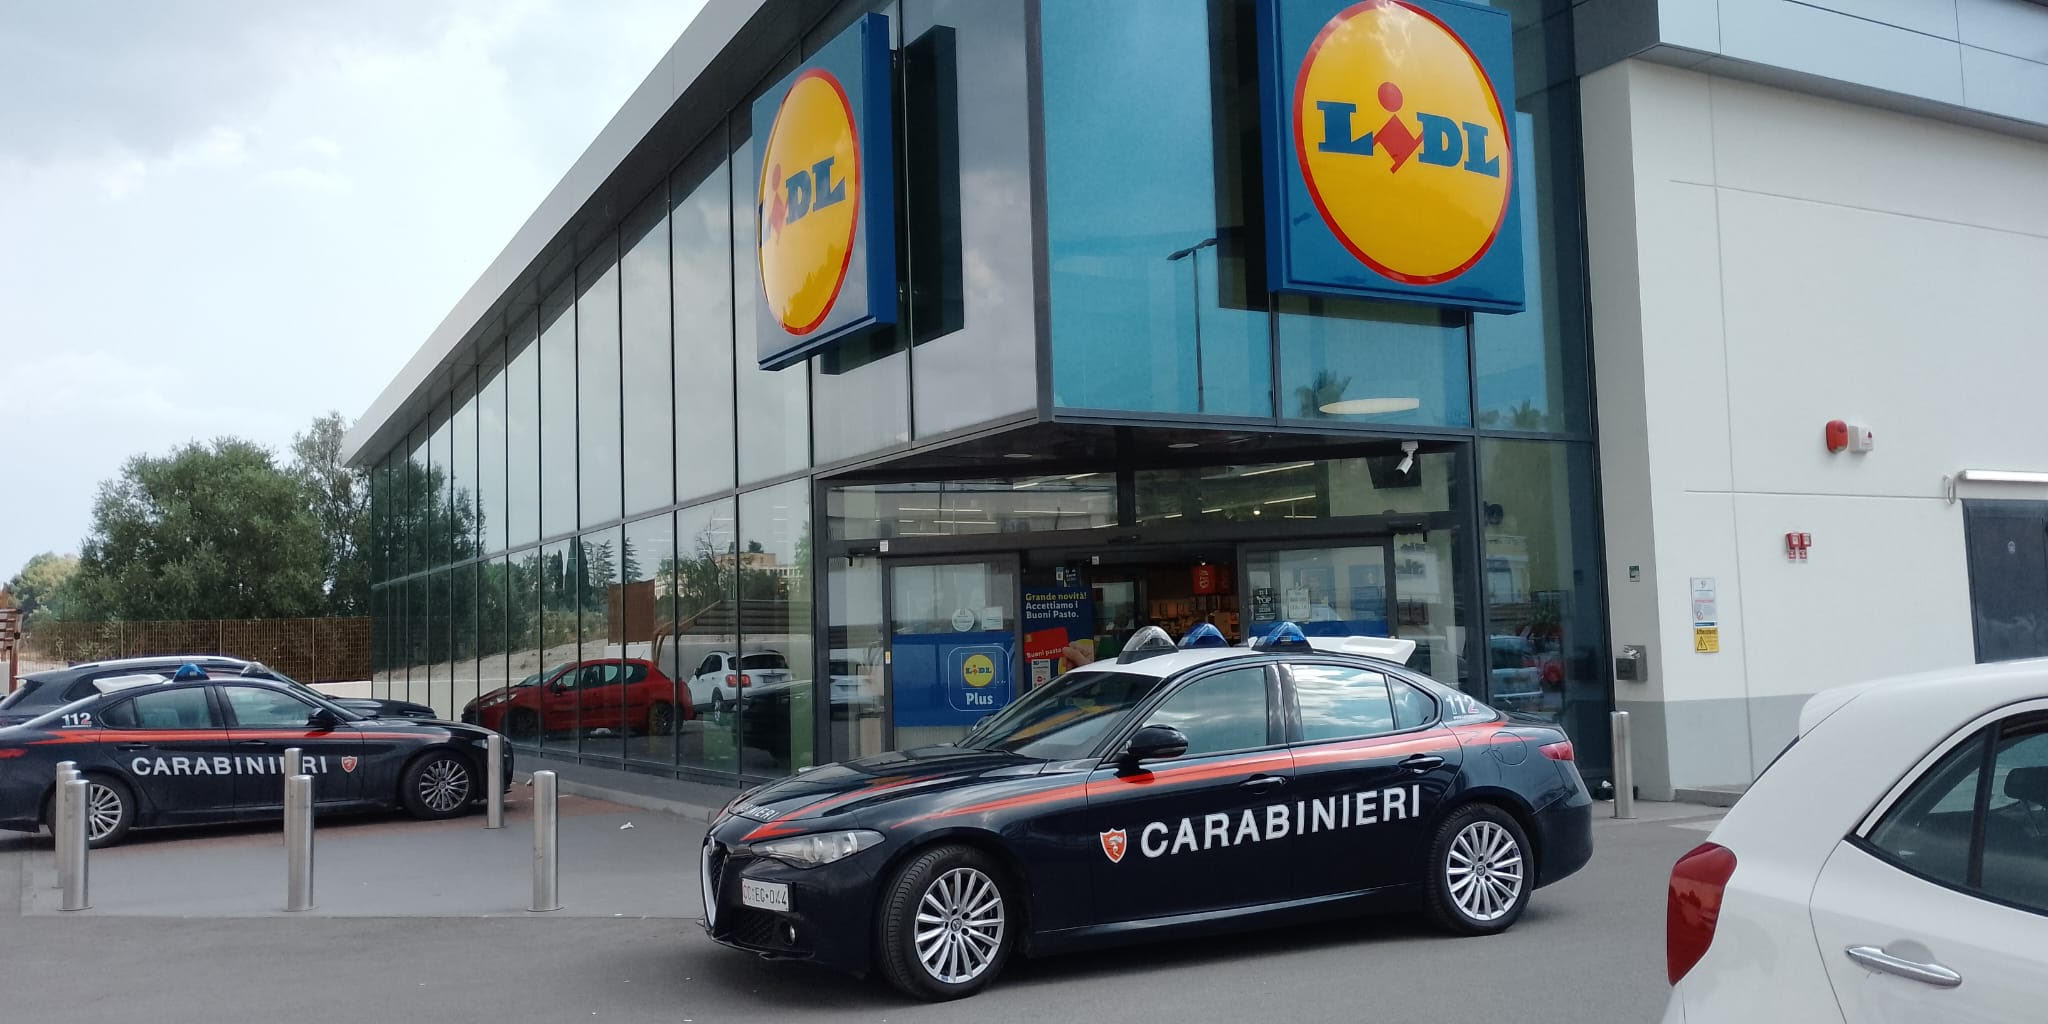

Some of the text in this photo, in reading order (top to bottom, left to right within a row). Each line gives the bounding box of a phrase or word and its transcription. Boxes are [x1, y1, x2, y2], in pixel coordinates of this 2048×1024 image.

[1316, 81, 1500, 179] LIDL
[1025, 592, 1057, 601] Grande
[1025, 601, 1074, 610] Accettiamo
[1026, 610, 1051, 619] Buoni
[965, 664, 992, 676] LIDL
[965, 692, 994, 705] Plus
[1445, 694, 1480, 715] 112
[61, 712, 92, 726] 112
[131, 755, 328, 776] CARABINIRI
[1140, 784, 1420, 859] CARABINIERI
